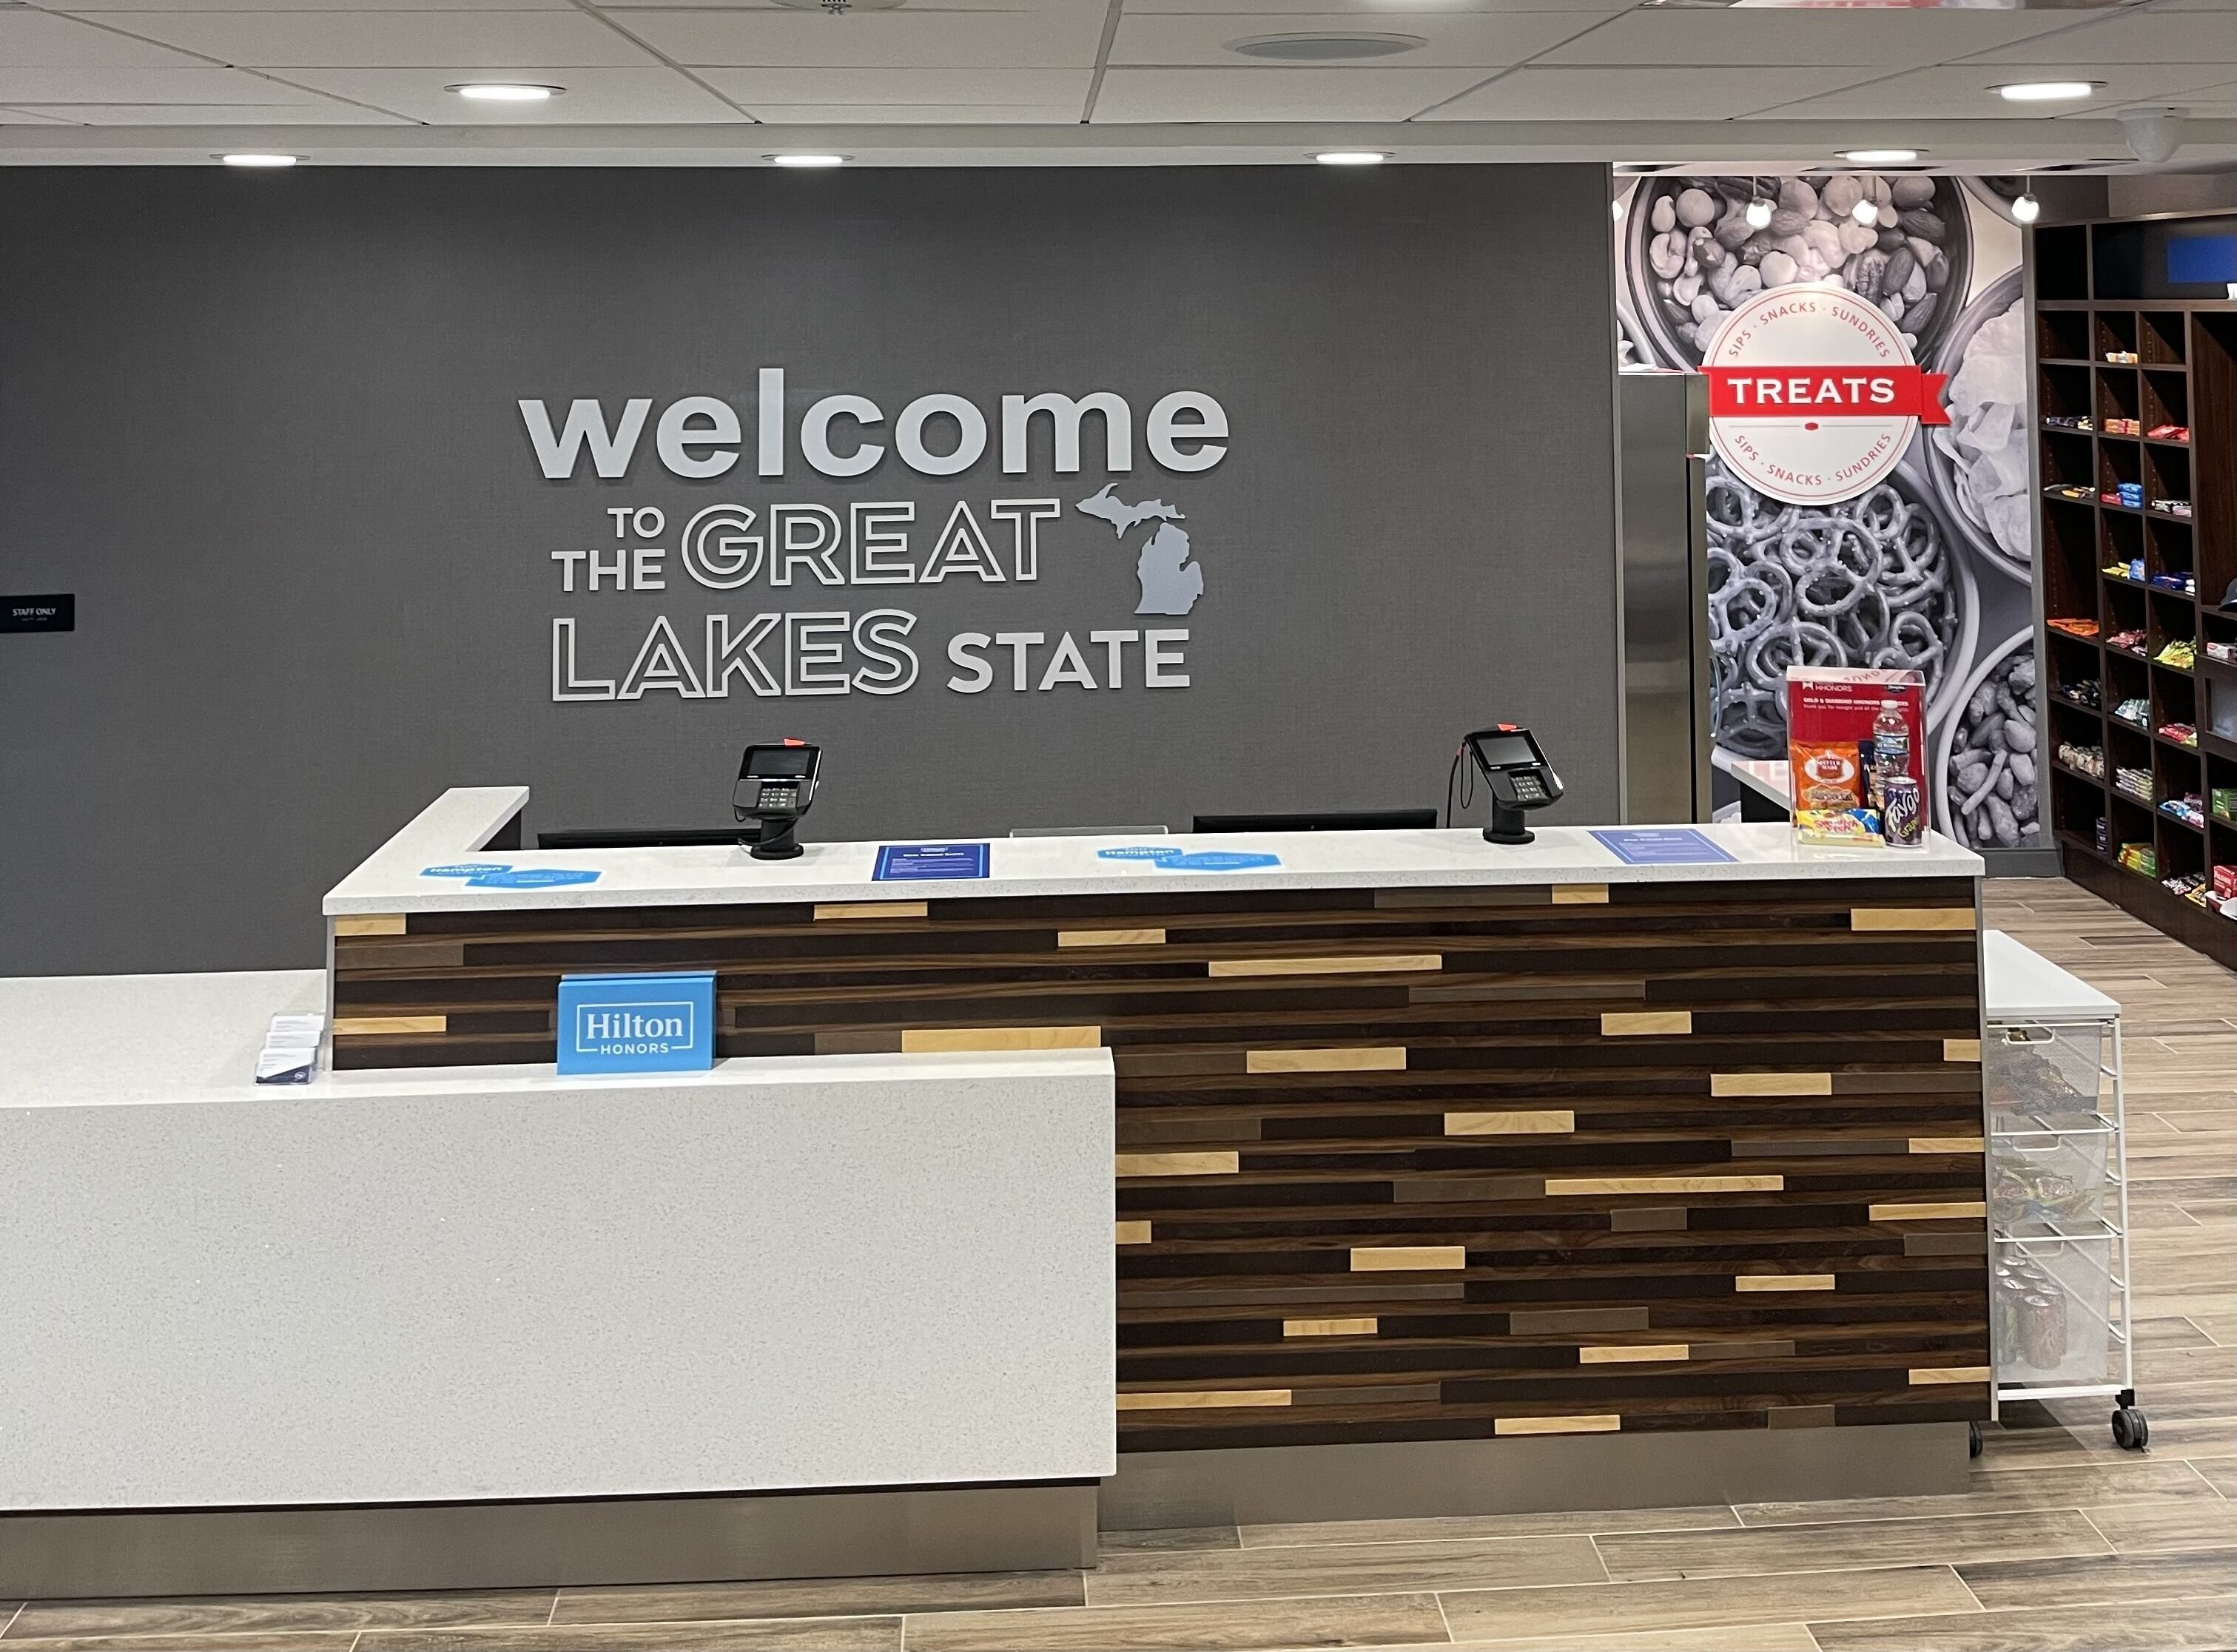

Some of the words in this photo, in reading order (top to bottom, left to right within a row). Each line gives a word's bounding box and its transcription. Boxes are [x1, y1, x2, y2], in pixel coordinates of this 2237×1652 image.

[1729, 329, 1752, 358] SIPS
[1760, 302, 1817, 326] SNACKS
[1831, 306, 1891, 359] SUNDRIES
[1727, 377, 1895, 404] TREATS
[518, 368, 1229, 479] welcome
[1735, 435, 1757, 462] SIPS
[1766, 464, 1822, 486] SNACKS
[1835, 433, 1891, 482] SUNDRIES
[607, 506, 665, 539] TO
[551, 548, 665, 591] THE
[681, 498, 1060, 589] GREAT
[13, 607, 34, 616] STAFF
[36, 607, 56, 616] ONLY
[552, 608, 919, 701] LAKES
[947, 628, 1191, 693] STATE
[586, 1013, 683, 1039] Hilton
[601, 1042, 669, 1055] HONORS
